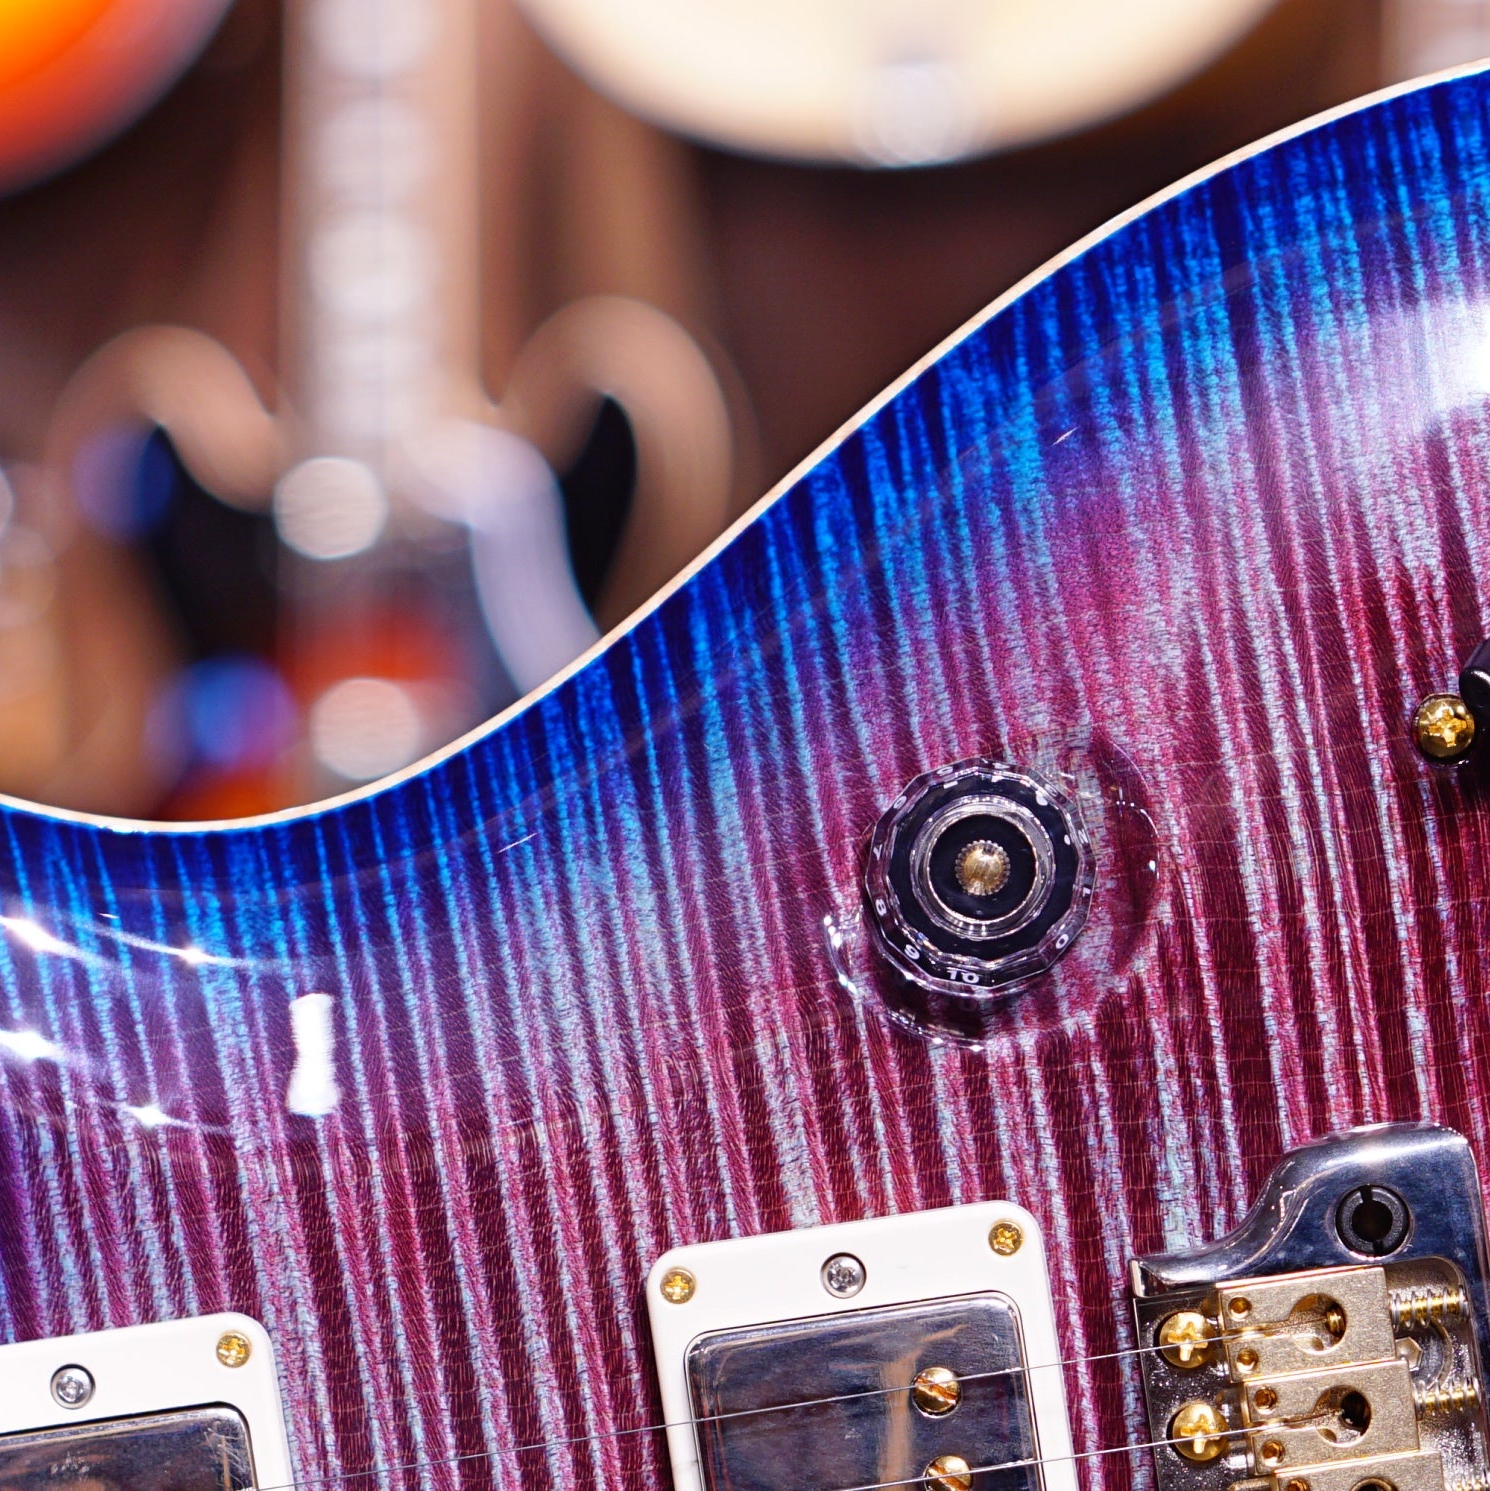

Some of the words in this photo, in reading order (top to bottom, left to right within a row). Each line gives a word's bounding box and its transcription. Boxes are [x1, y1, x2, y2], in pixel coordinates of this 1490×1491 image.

[875, 899, 887, 916] 8
[1056, 934, 1069, 949] 0
[904, 944, 920, 960] 9
[946, 967, 980, 984] 10
